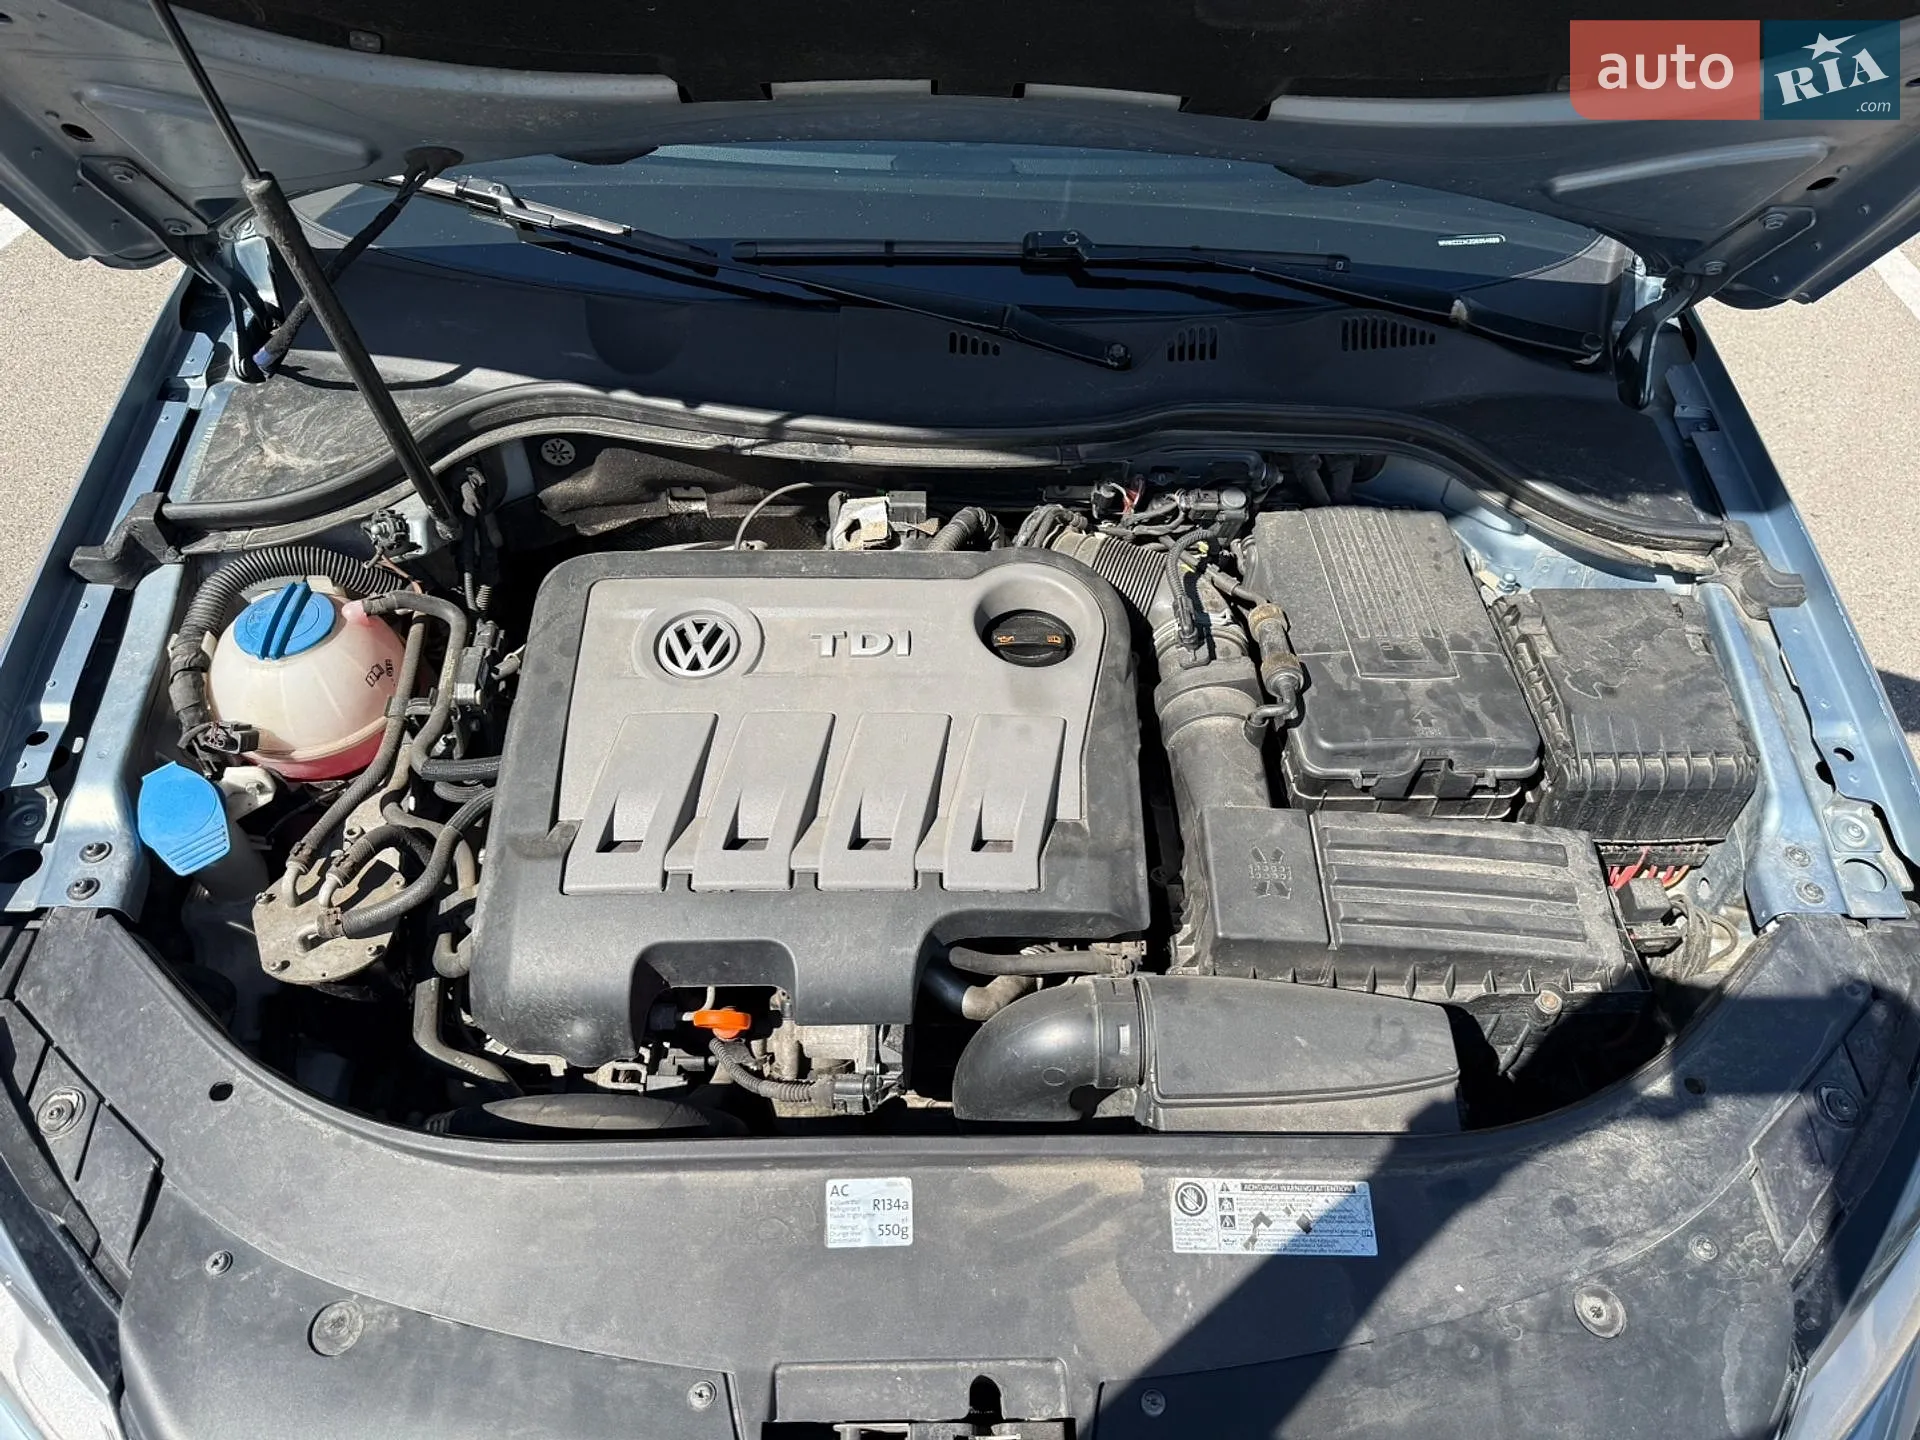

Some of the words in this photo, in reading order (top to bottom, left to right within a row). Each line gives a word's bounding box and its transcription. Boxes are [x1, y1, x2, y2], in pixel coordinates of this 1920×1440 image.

[811, 630, 913, 658] TDI
[830, 1184, 849, 1197] AC
[873, 1198, 909, 1211] R134a
[878, 1223, 909, 1240] 550g
